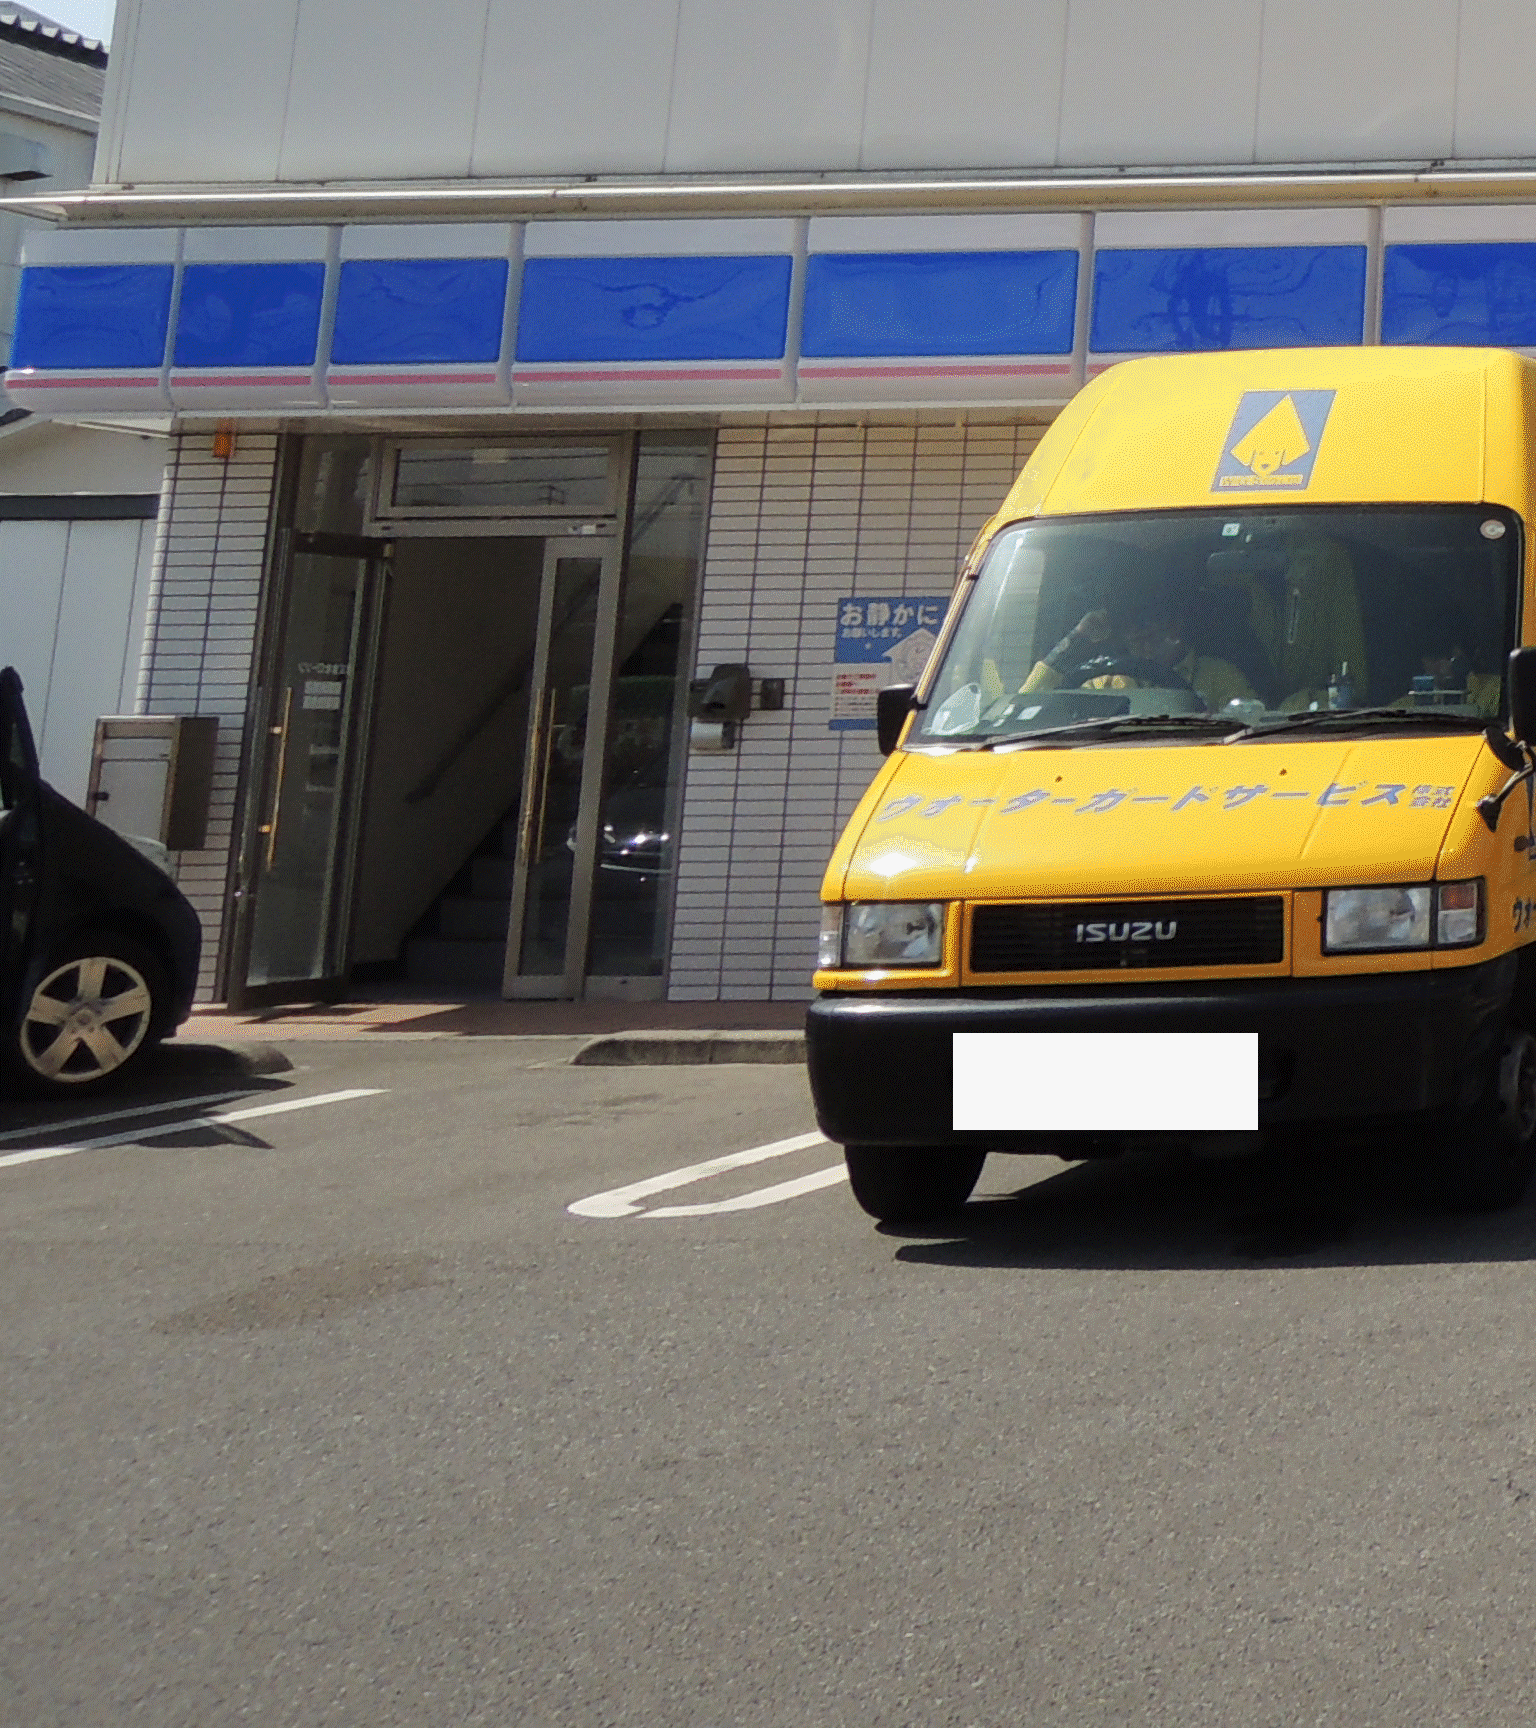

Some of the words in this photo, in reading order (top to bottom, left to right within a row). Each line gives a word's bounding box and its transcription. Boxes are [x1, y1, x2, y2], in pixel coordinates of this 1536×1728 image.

[840, 602, 938, 627] お静かに
[876, 781, 1406, 822] ウォーターガードサービス
[1075, 920, 1177, 943] ISUZU
